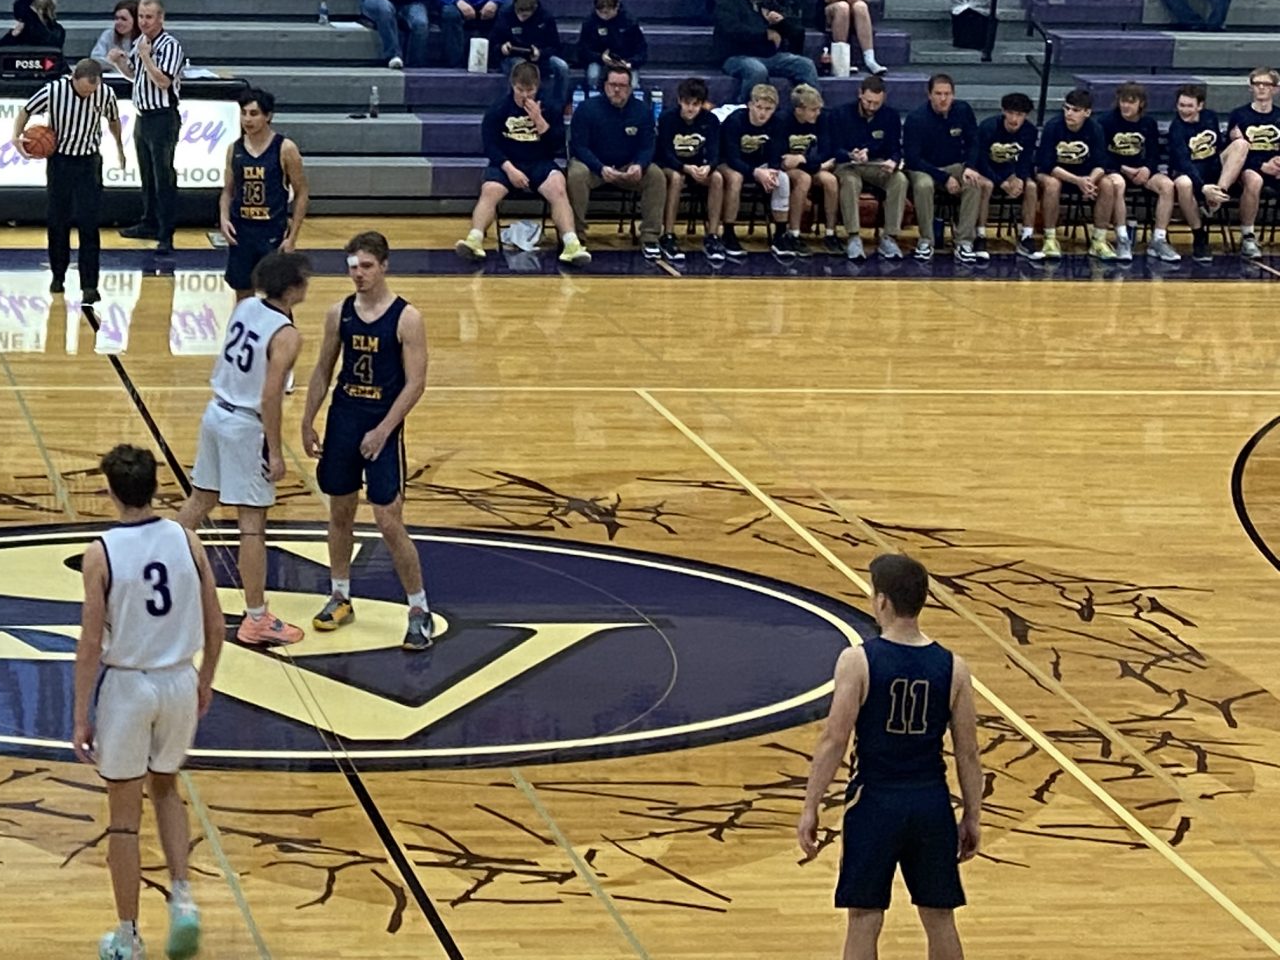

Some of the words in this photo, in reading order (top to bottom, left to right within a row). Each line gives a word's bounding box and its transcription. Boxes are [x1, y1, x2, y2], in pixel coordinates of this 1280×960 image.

[15, 59, 43, 69] POSS.
[224, 321, 261, 374] 25
[351, 334, 380, 353] ELM
[352, 353, 374, 385] 4
[143, 561, 173, 617] 3
[885, 677, 930, 735] 11
